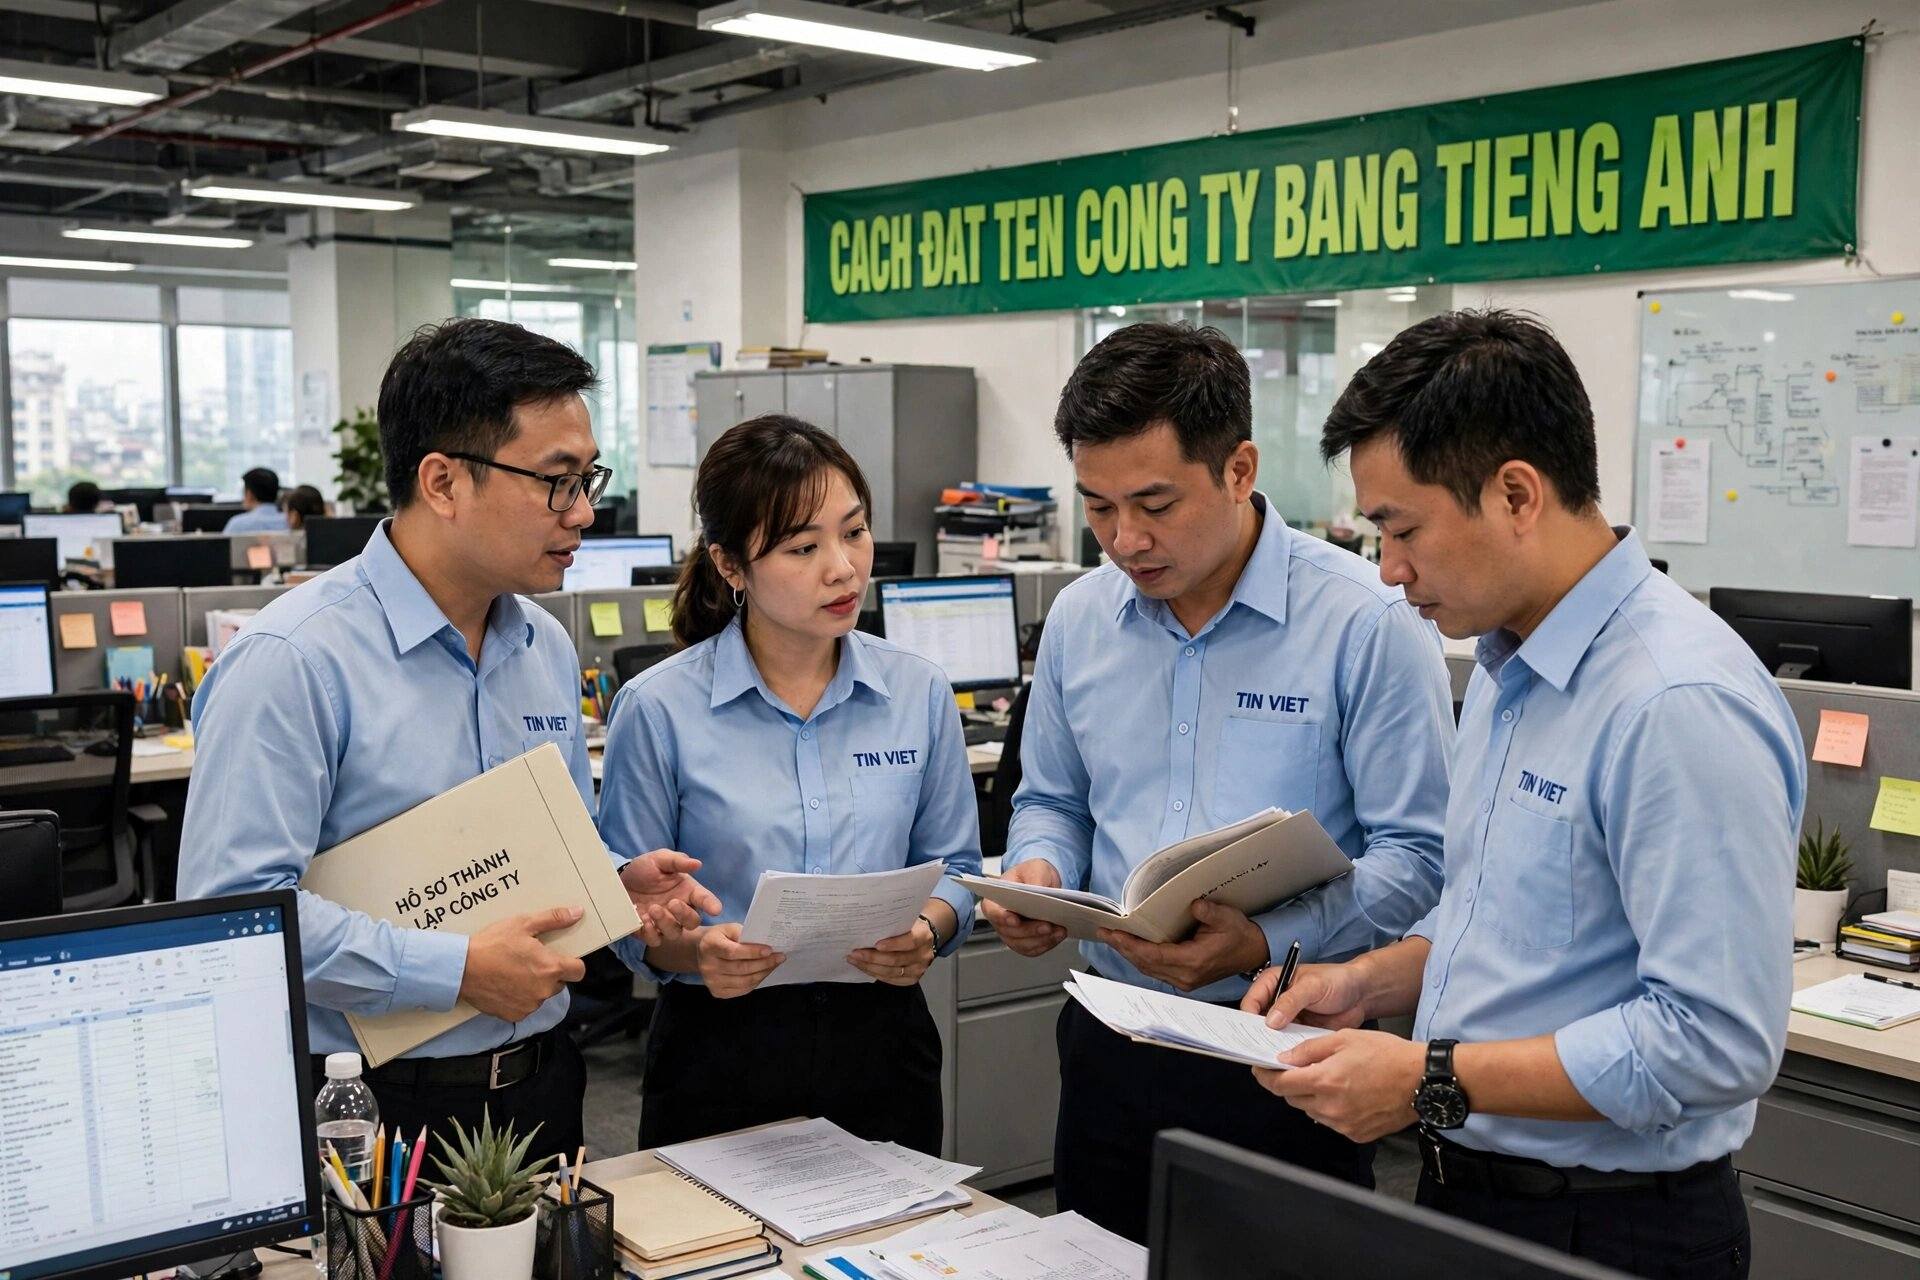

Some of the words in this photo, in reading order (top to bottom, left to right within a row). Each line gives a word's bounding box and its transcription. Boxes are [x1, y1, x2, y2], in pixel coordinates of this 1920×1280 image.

[830, 214, 912, 294] CACH
[994, 195, 1063, 281] TEN
[1076, 177, 1187, 275] CONG
[1199, 164, 1260, 264] TY
[1273, 149, 1418, 259] BANG
[1436, 123, 1619, 244] TIENG
[1639, 99, 1796, 228] ANH
[1236, 691, 1264, 709] TIN
[1268, 694, 1310, 714] VIET
[522, 715, 546, 732] TIN
[545, 715, 568, 732] VIET
[852, 752, 881, 768] TIN
[883, 749, 918, 766] VIET
[1518, 769, 1539, 793] TIN
[1537, 777, 1568, 805] VIET
[394, 886, 422, 915] HỒ
[423, 876, 449, 902] SƠ
[448, 848, 510, 887] THÀNH
[413, 904, 447, 931] LẬP
[448, 883, 498, 915] CÔNG
[498, 869, 520, 891] TY
